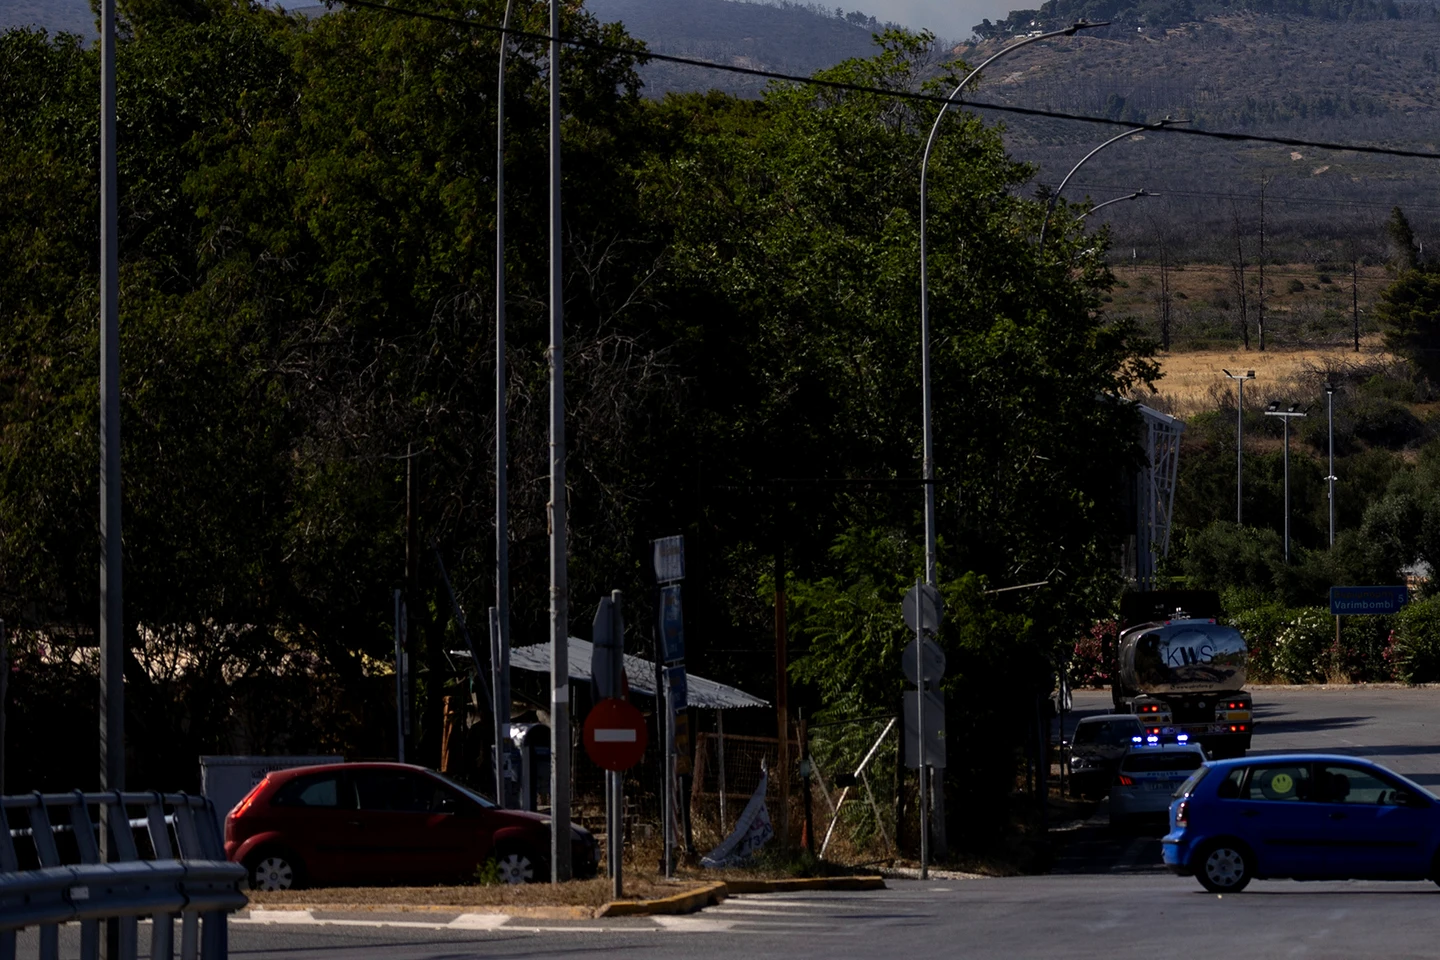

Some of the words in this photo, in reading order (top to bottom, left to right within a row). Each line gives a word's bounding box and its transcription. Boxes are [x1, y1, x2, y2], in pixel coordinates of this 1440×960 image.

[1334, 600, 1394, 609] Varimbombi
[1397, 594, 1405, 603] 5
[1166, 645, 1214, 667] KWS
